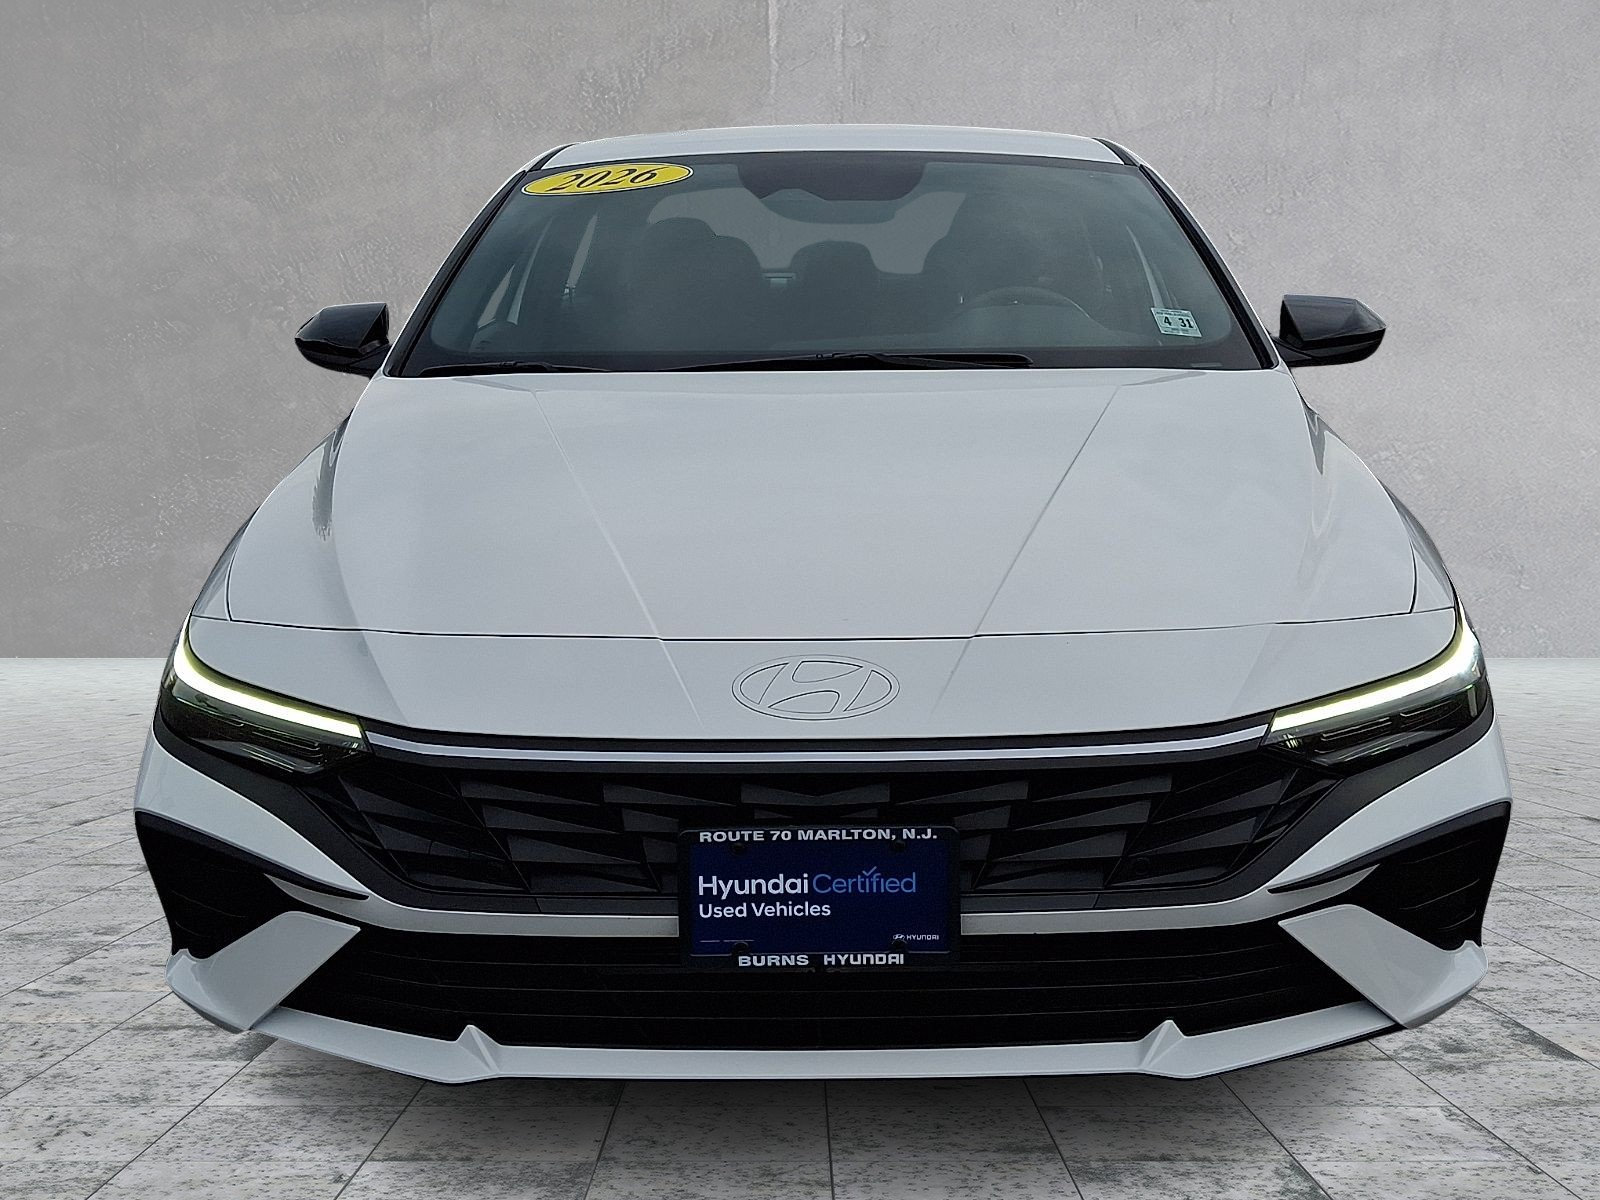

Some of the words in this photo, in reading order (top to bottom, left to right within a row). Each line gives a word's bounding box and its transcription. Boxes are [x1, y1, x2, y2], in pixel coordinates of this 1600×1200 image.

[545, 166, 669, 192] 2026
[1164, 316, 1172, 326] 4
[1178, 317, 1193, 328] 31
[699, 830, 765, 843] ROUTE
[770, 830, 792, 841] 70
[797, 828, 896, 841] MARLTON,
[902, 828, 938, 840] N.J.
[698, 873, 809, 900] Hyundai
[812, 867, 917, 894] Certified
[699, 902, 748, 918] Used
[751, 900, 831, 917] Vehicles
[738, 954, 809, 967] BURNS
[823, 953, 905, 966] HYUNDAI
